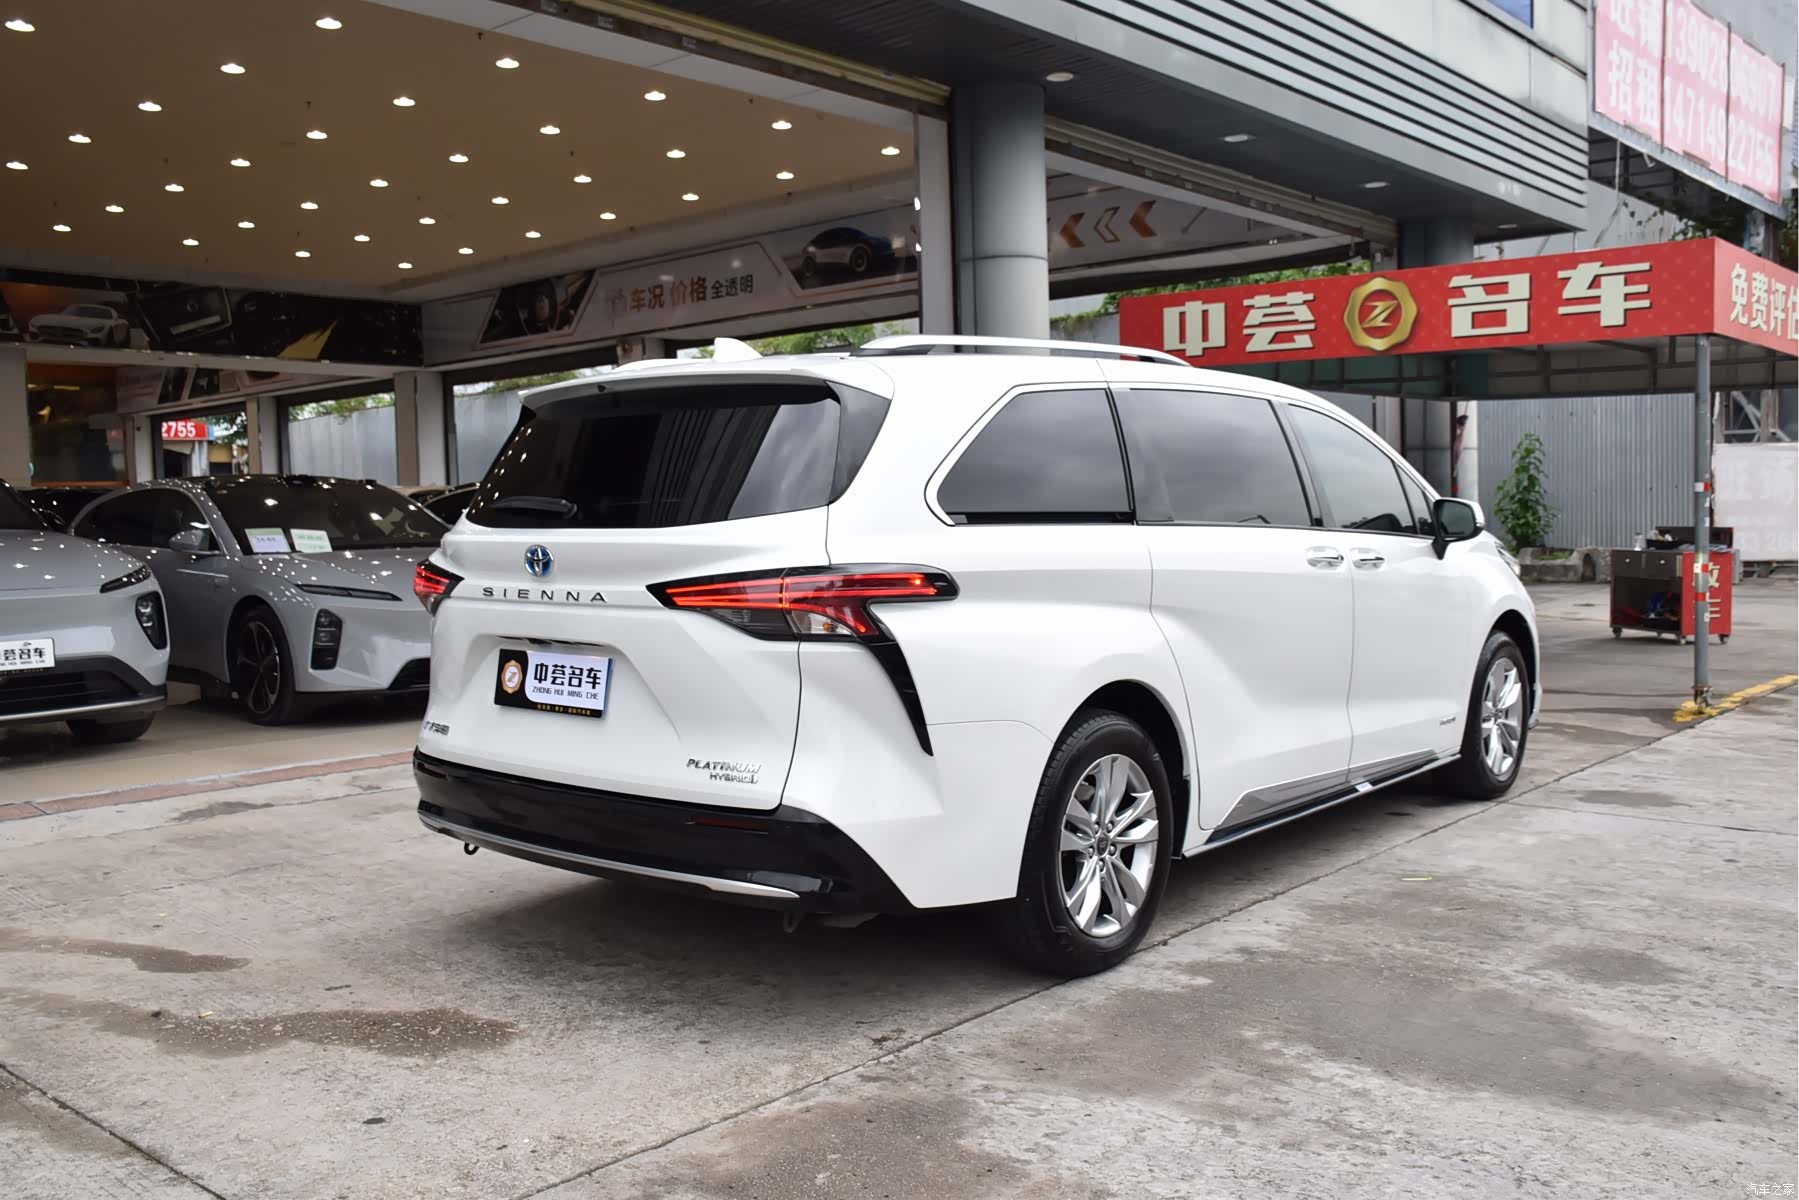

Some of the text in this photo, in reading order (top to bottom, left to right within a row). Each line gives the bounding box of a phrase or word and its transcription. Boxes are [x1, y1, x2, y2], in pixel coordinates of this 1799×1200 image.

[1608, 39, 1658, 128] 招租
[671, 276, 708, 305] 价格
[711, 274, 753, 300] 全透明
[1729, 262, 1798, 340] 免费评估
[1162, 293, 1315, 358] 中荟
[1447, 261, 1652, 338] 名车
[161, 421, 197, 438] 2755
[482, 586, 607, 603] SIENNA
[533, 662, 603, 690] 中荟名车
[532, 686, 600, 701] ZHONG HUI MING CHE
[687, 758, 761, 774] PLATINUM
